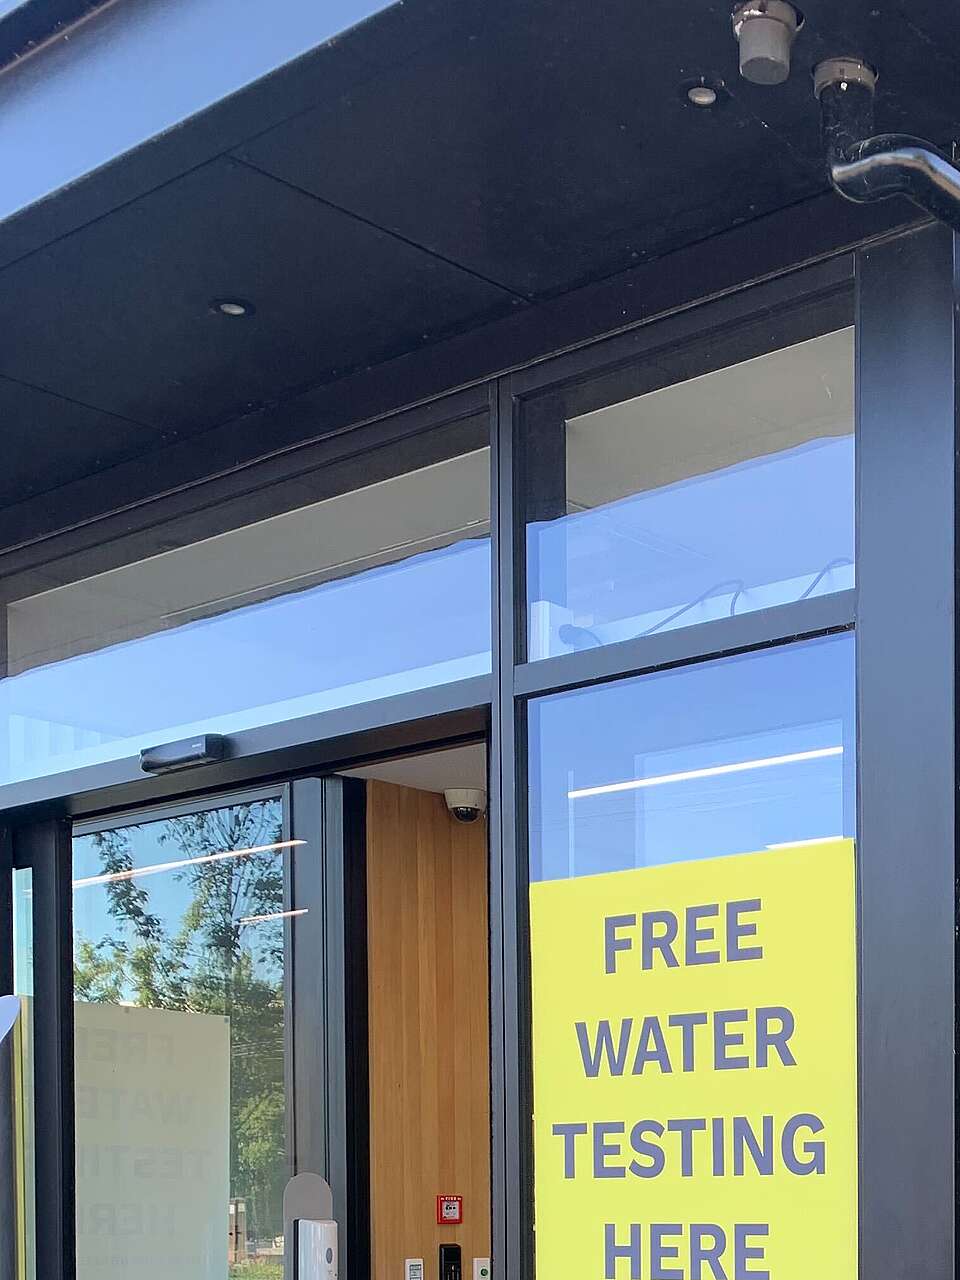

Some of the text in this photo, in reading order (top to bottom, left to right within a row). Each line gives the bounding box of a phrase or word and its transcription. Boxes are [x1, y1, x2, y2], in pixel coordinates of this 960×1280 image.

[604, 898, 763, 974] FREE
[574, 1006, 797, 1078] WATER
[552, 1113, 825, 1179] TESTING
